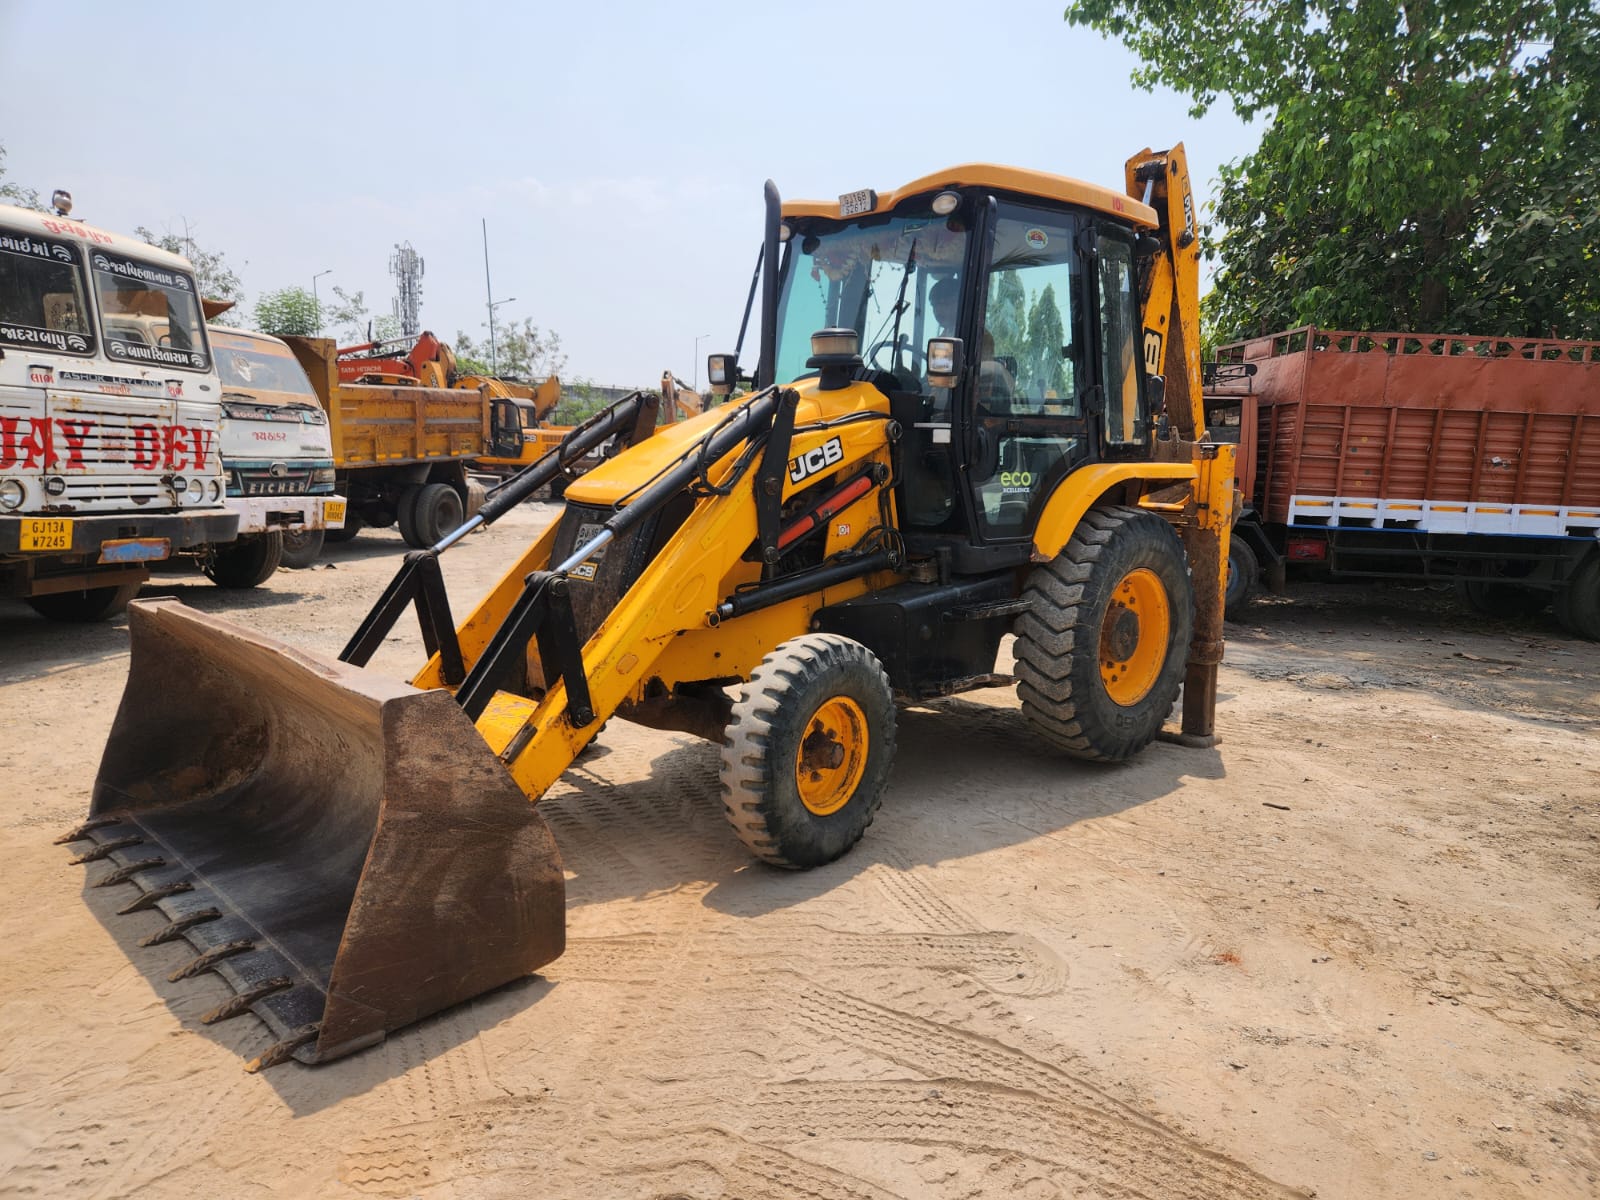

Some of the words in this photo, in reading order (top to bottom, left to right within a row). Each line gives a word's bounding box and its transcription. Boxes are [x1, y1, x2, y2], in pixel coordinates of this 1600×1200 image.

[63, 373, 105, 383] ASHOK
[112, 376, 162, 387] LEYLAND
[133, 423, 214, 471] DEV
[790, 438, 843, 482] JCB
[1000, 471, 1031, 487] eco
[249, 482, 306, 495] EICHER
[32, 521, 65, 534] GJ13A
[32, 535, 65, 548] W7245
